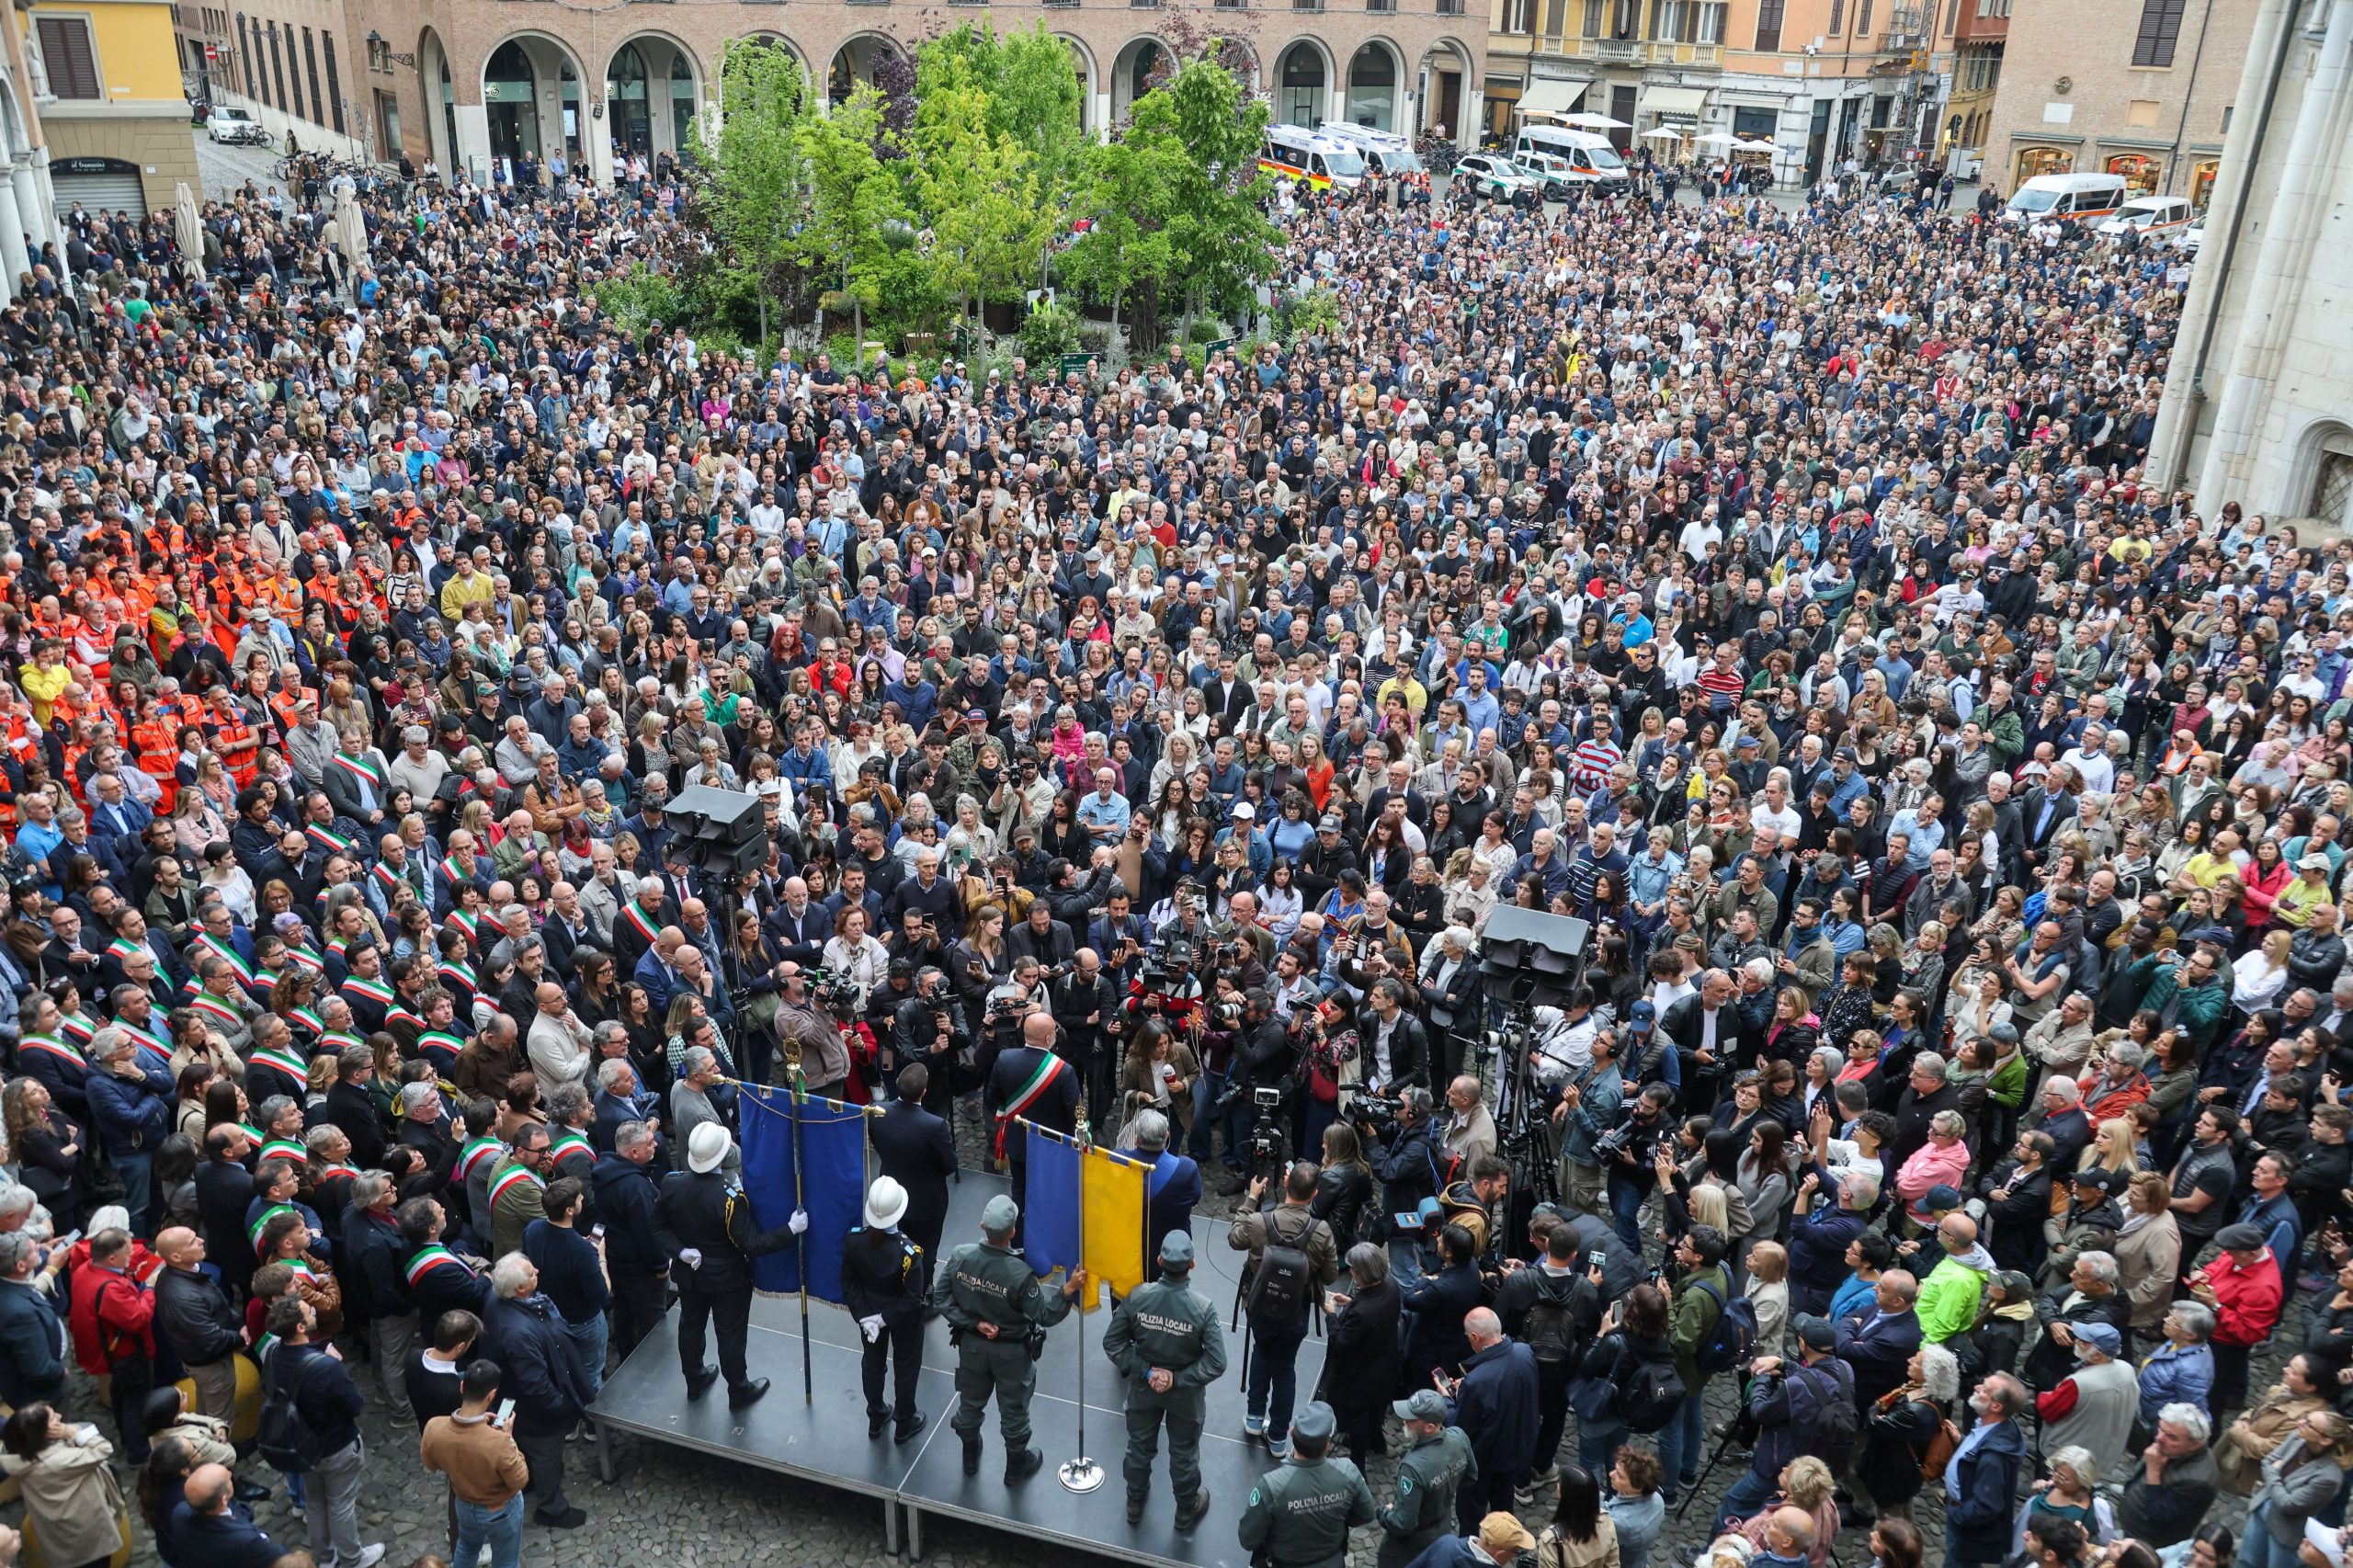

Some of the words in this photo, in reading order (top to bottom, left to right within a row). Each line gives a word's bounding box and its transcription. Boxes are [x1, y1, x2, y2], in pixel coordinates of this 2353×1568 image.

[957, 1272, 981, 1286] POLIZIA
[982, 1279, 1008, 1297] LOCALE
[1136, 1312, 1164, 1325] POLIZIA
[1165, 1317, 1193, 1332] LOCALE
[1140, 1322, 1162, 1331] PROVINCIA
[1288, 1497, 1319, 1510] POLIZIA
[1320, 1489, 1347, 1505] LOCALE
